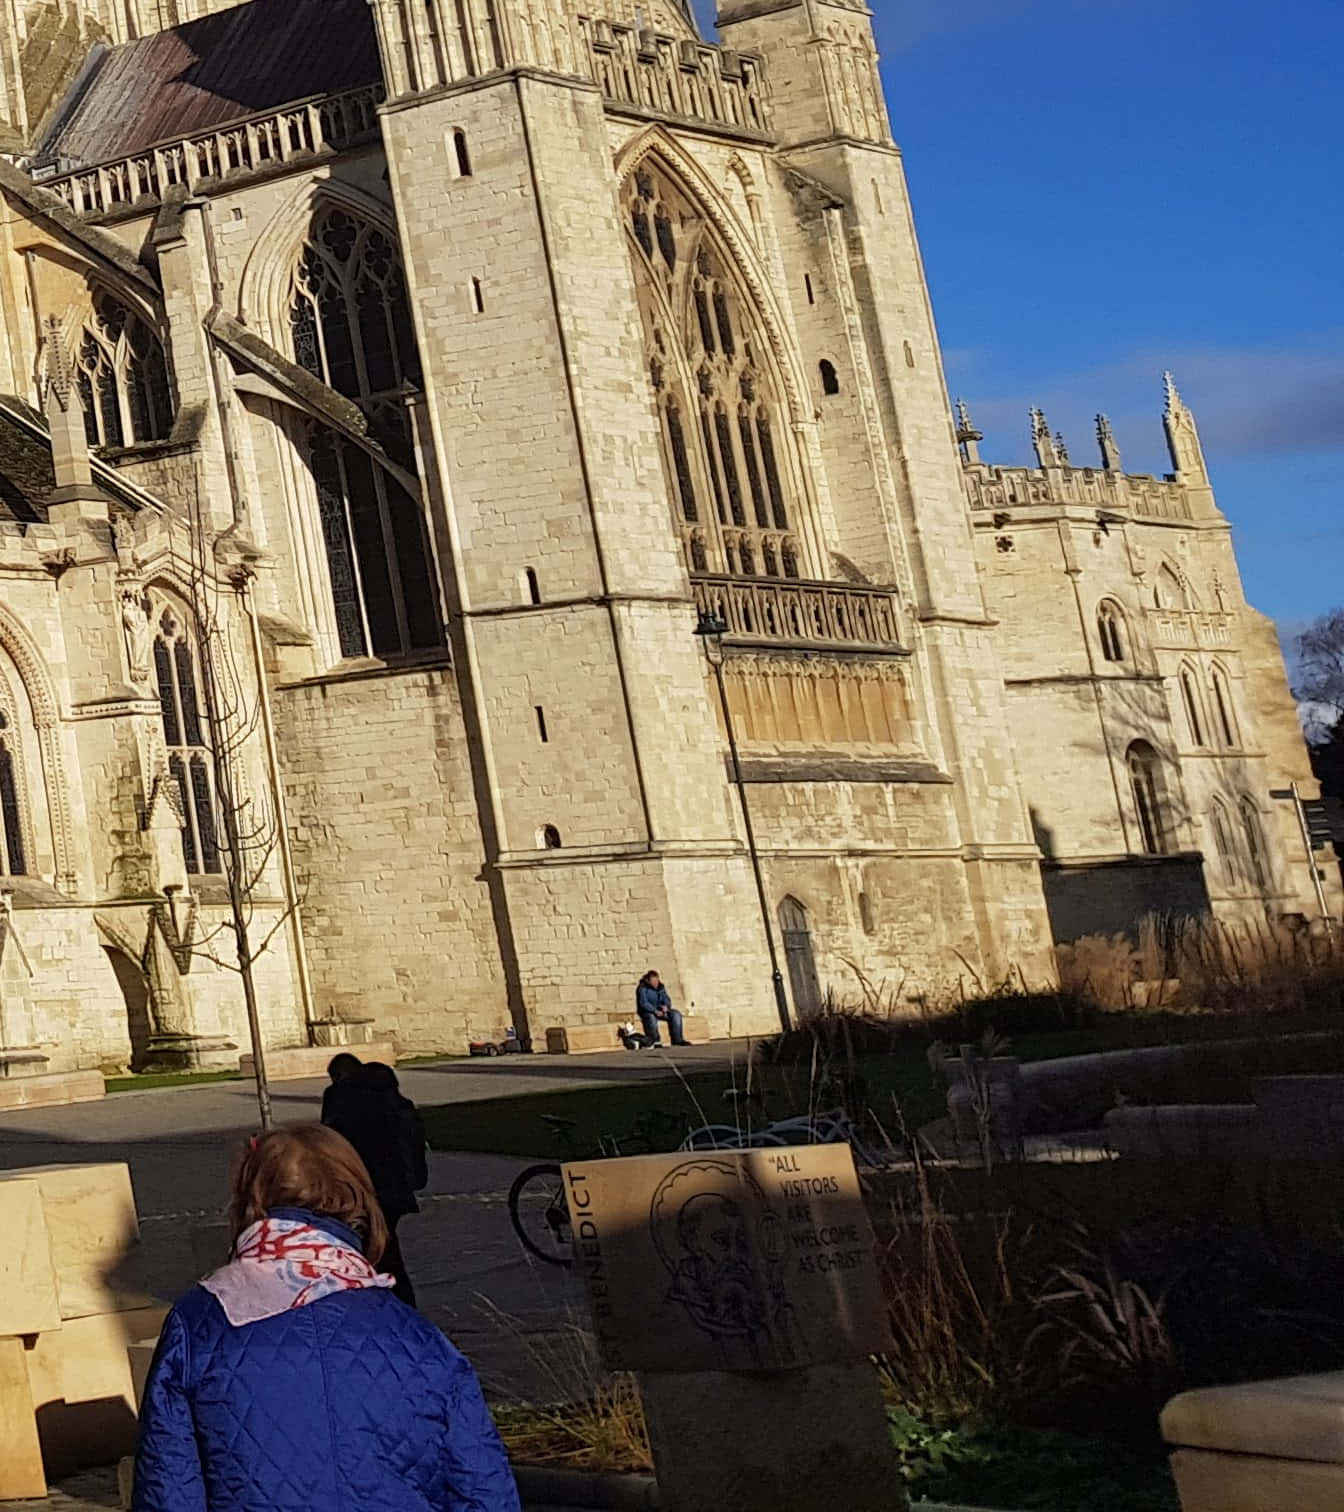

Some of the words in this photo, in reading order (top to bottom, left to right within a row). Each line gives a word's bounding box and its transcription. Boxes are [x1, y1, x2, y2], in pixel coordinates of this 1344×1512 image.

[780, 1176, 839, 1198] VISITORS
[787, 1205, 812, 1223] ARE
[568, 1170, 611, 1318] BENEDICT
[790, 1225, 860, 1248] WELCOME
